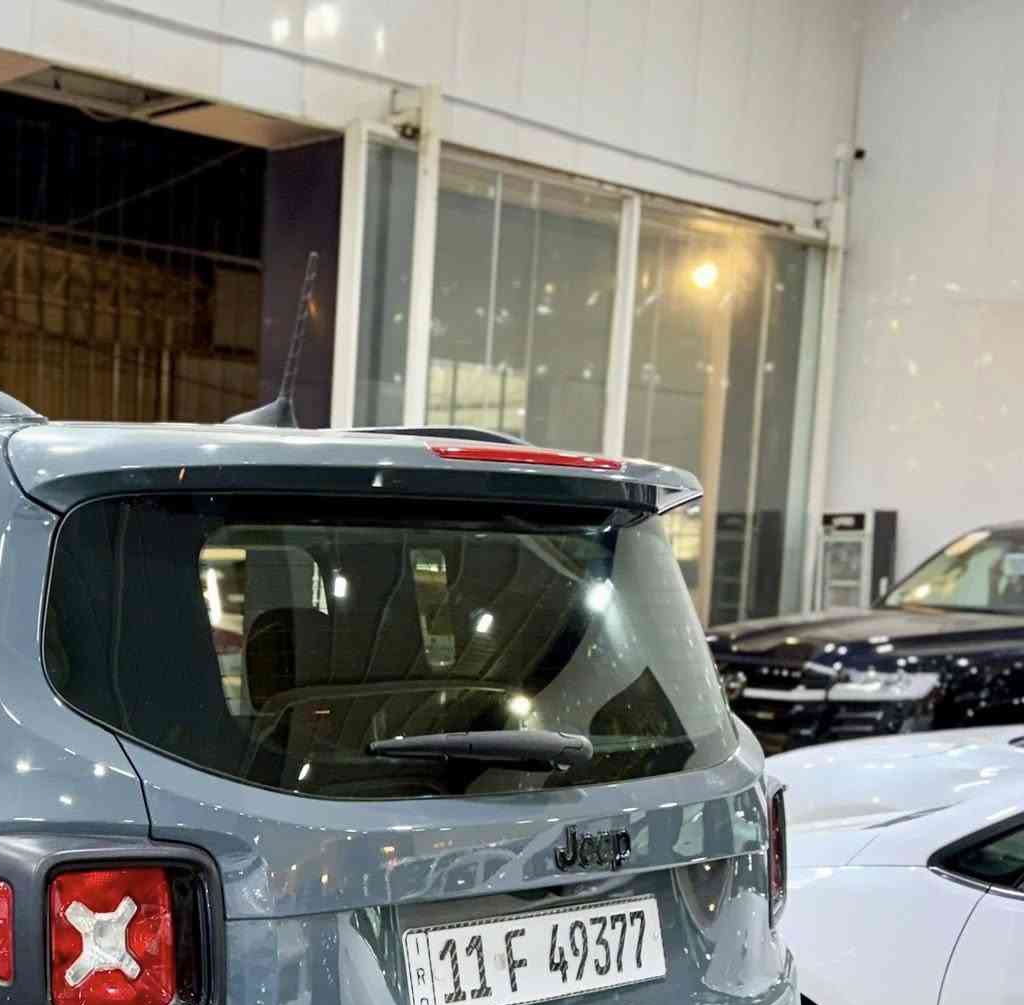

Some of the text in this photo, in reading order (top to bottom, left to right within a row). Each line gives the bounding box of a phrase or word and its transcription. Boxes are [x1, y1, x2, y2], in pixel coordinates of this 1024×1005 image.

[554, 823, 632, 872] Jeep
[439, 910, 645, 1004] 11 F 49377
